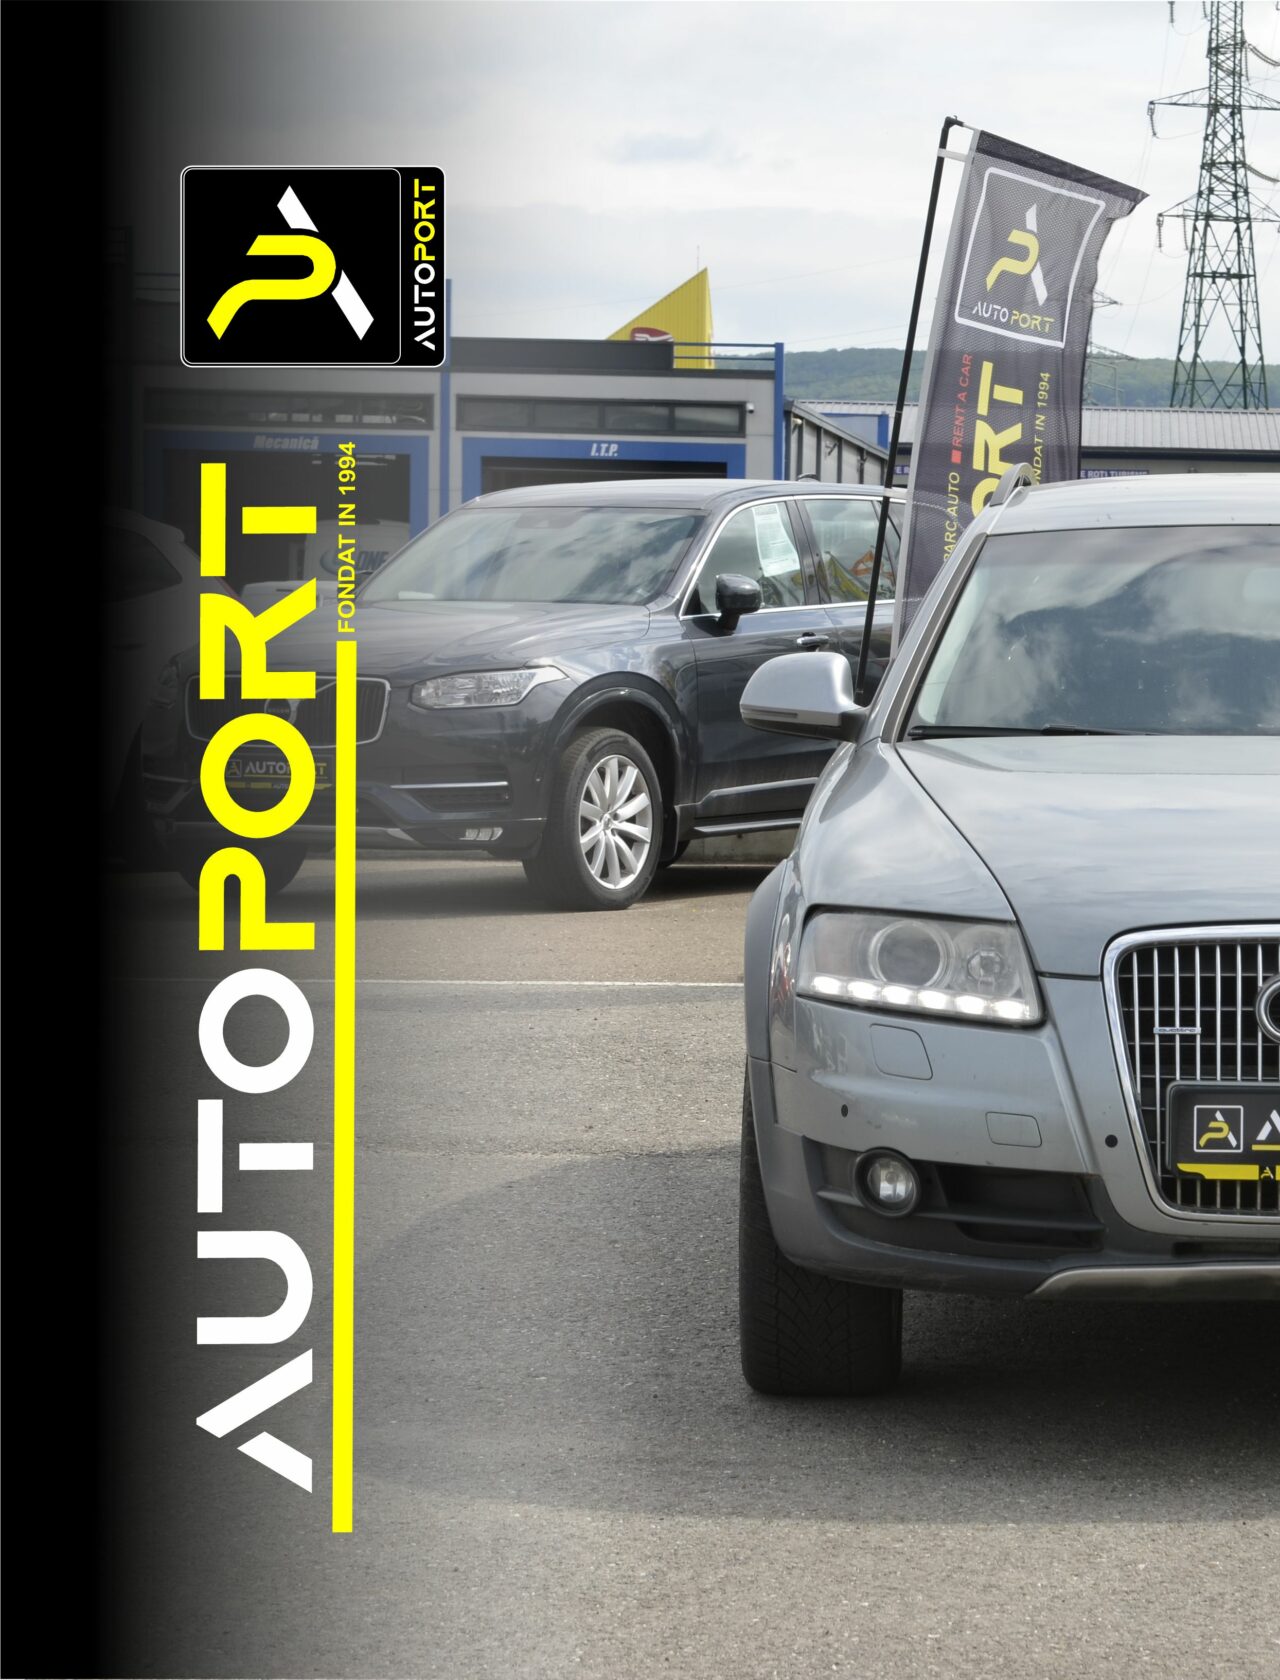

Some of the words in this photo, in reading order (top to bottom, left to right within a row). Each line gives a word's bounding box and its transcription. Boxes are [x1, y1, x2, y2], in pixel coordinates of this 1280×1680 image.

[960, 353, 972, 387] CAR
[957, 391, 968, 402] A
[1037, 372, 1051, 408] 1994
[952, 405, 967, 447] RENT
[971, 361, 1024, 517] ORT
[1035, 414, 1046, 431] IN
[1033, 435, 1043, 484] NDAT
[947, 472, 960, 516] AUTO
